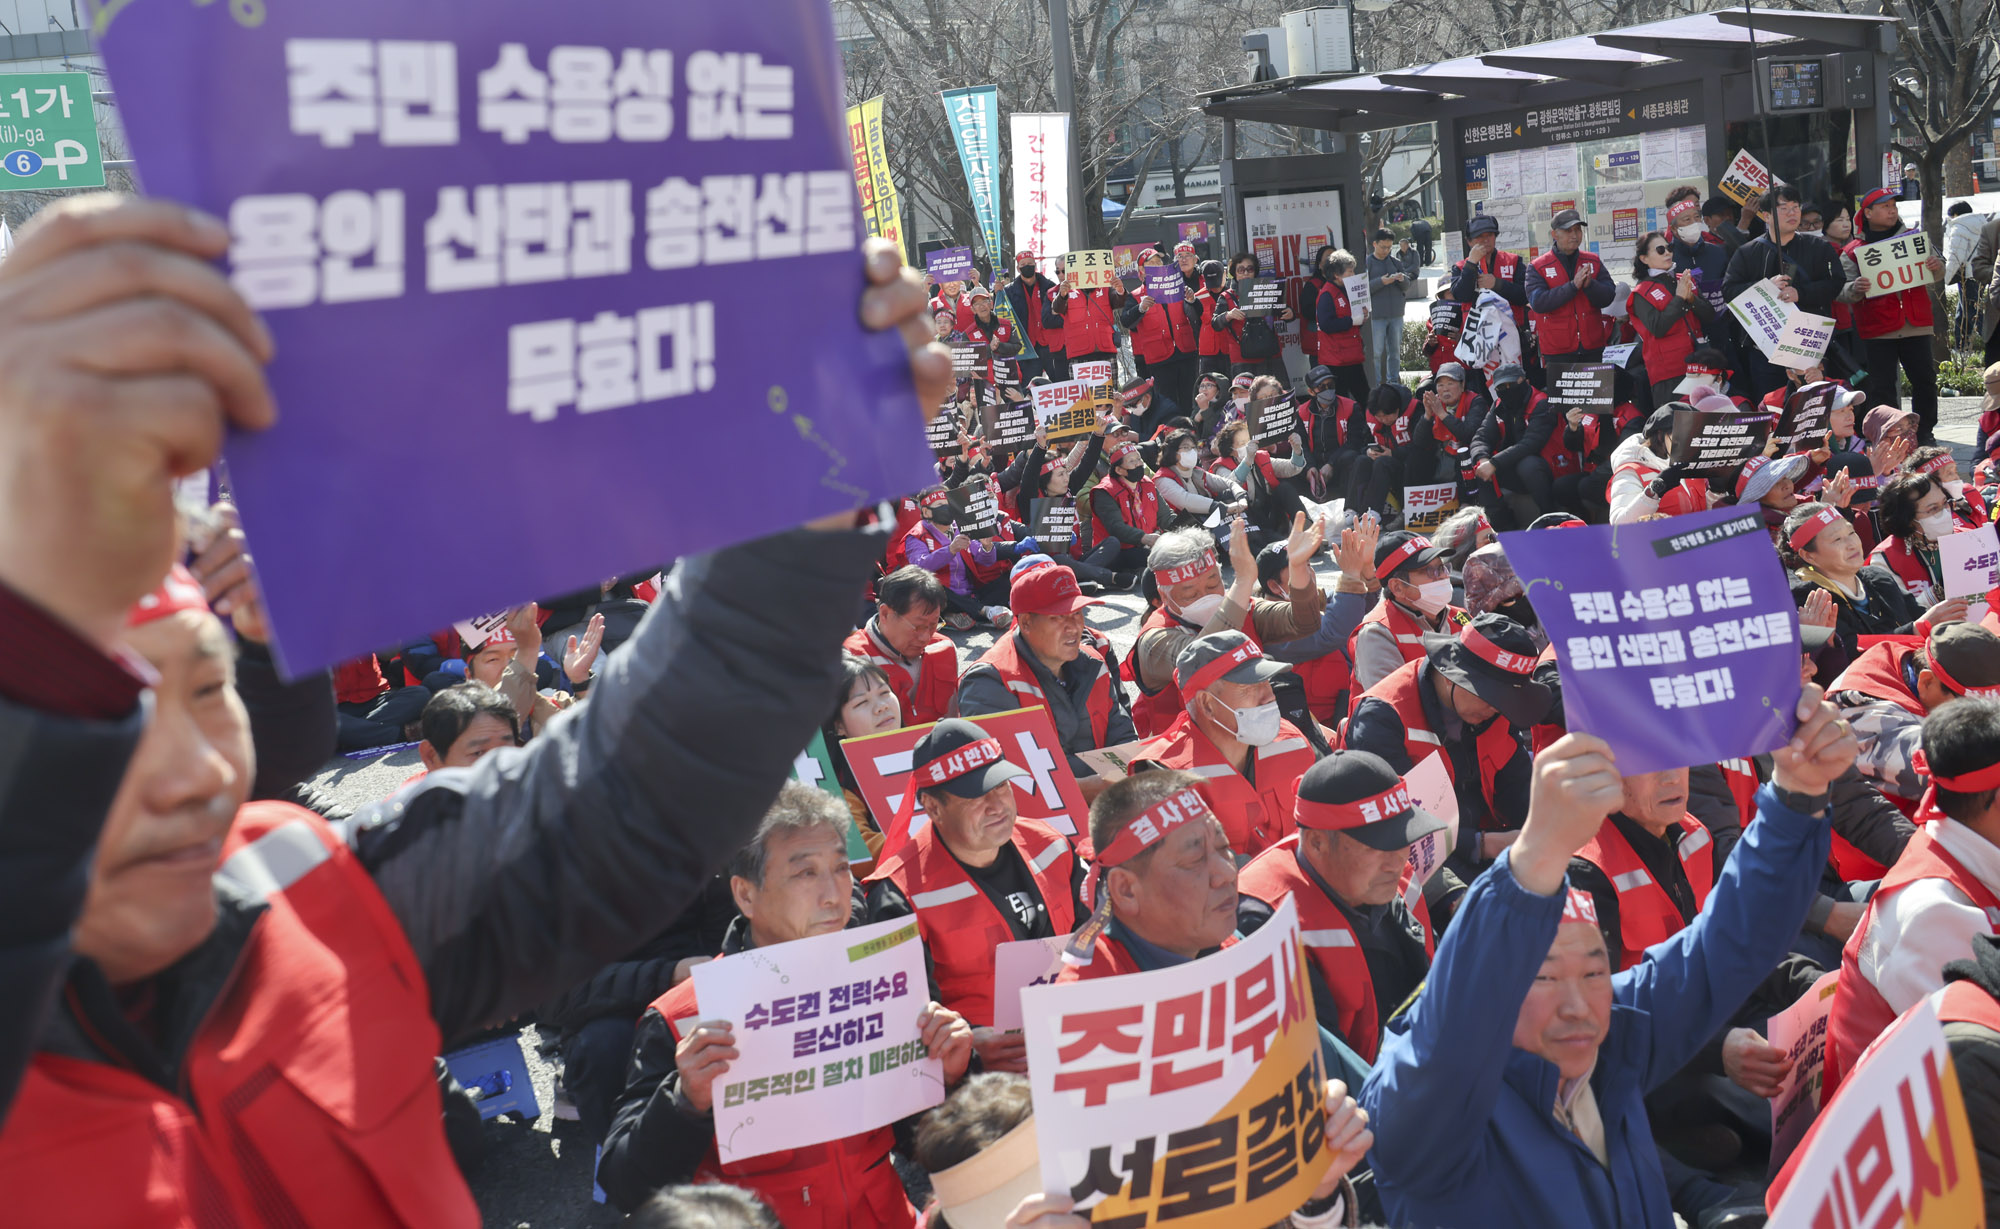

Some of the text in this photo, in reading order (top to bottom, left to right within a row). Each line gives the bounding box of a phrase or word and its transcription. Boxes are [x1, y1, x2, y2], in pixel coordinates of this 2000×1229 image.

[284, 37, 794, 147] 주민 수용성 없는
[1642, 98, 1689, 120] 세종문화회관
[1464, 122, 1512, 144] 신한은행본점
[16, 154, 32, 173] 6
[1472, 168, 1487, 179] 149
[228, 189, 406, 310] 용인
[646, 171, 856, 270] 송전선로
[1863, 236, 1926, 266] 송전탑
[1876, 261, 1926, 290] OUT
[508, 301, 715, 422] 무효다!
[1038, 383, 1091, 409] 주민무시
[1044, 408, 1095, 434] 선로결정
[1741, 455, 1772, 478] 결사반
[1847, 475, 1879, 489] 결사반
[1408, 487, 1457, 507] 주민무
[1705, 527, 1723, 542] 3.4
[1569, 577, 1753, 624] 주민 수용성 없는
[1567, 635, 1617, 671] 용인
[1689, 611, 1794, 660] 송전선로
[1649, 667, 1736, 710] 무효다!
[1128, 787, 1205, 845] 결사반
[744, 971, 908, 1031] 수도권 전력수요
[1053, 926, 1308, 1108] 주민무시
[793, 1012, 884, 1059] 분산하고
[723, 1067, 816, 1109] 민주적인
[822, 1056, 863, 1088] 절차
[1070, 1049, 1326, 1229] 선로결정
